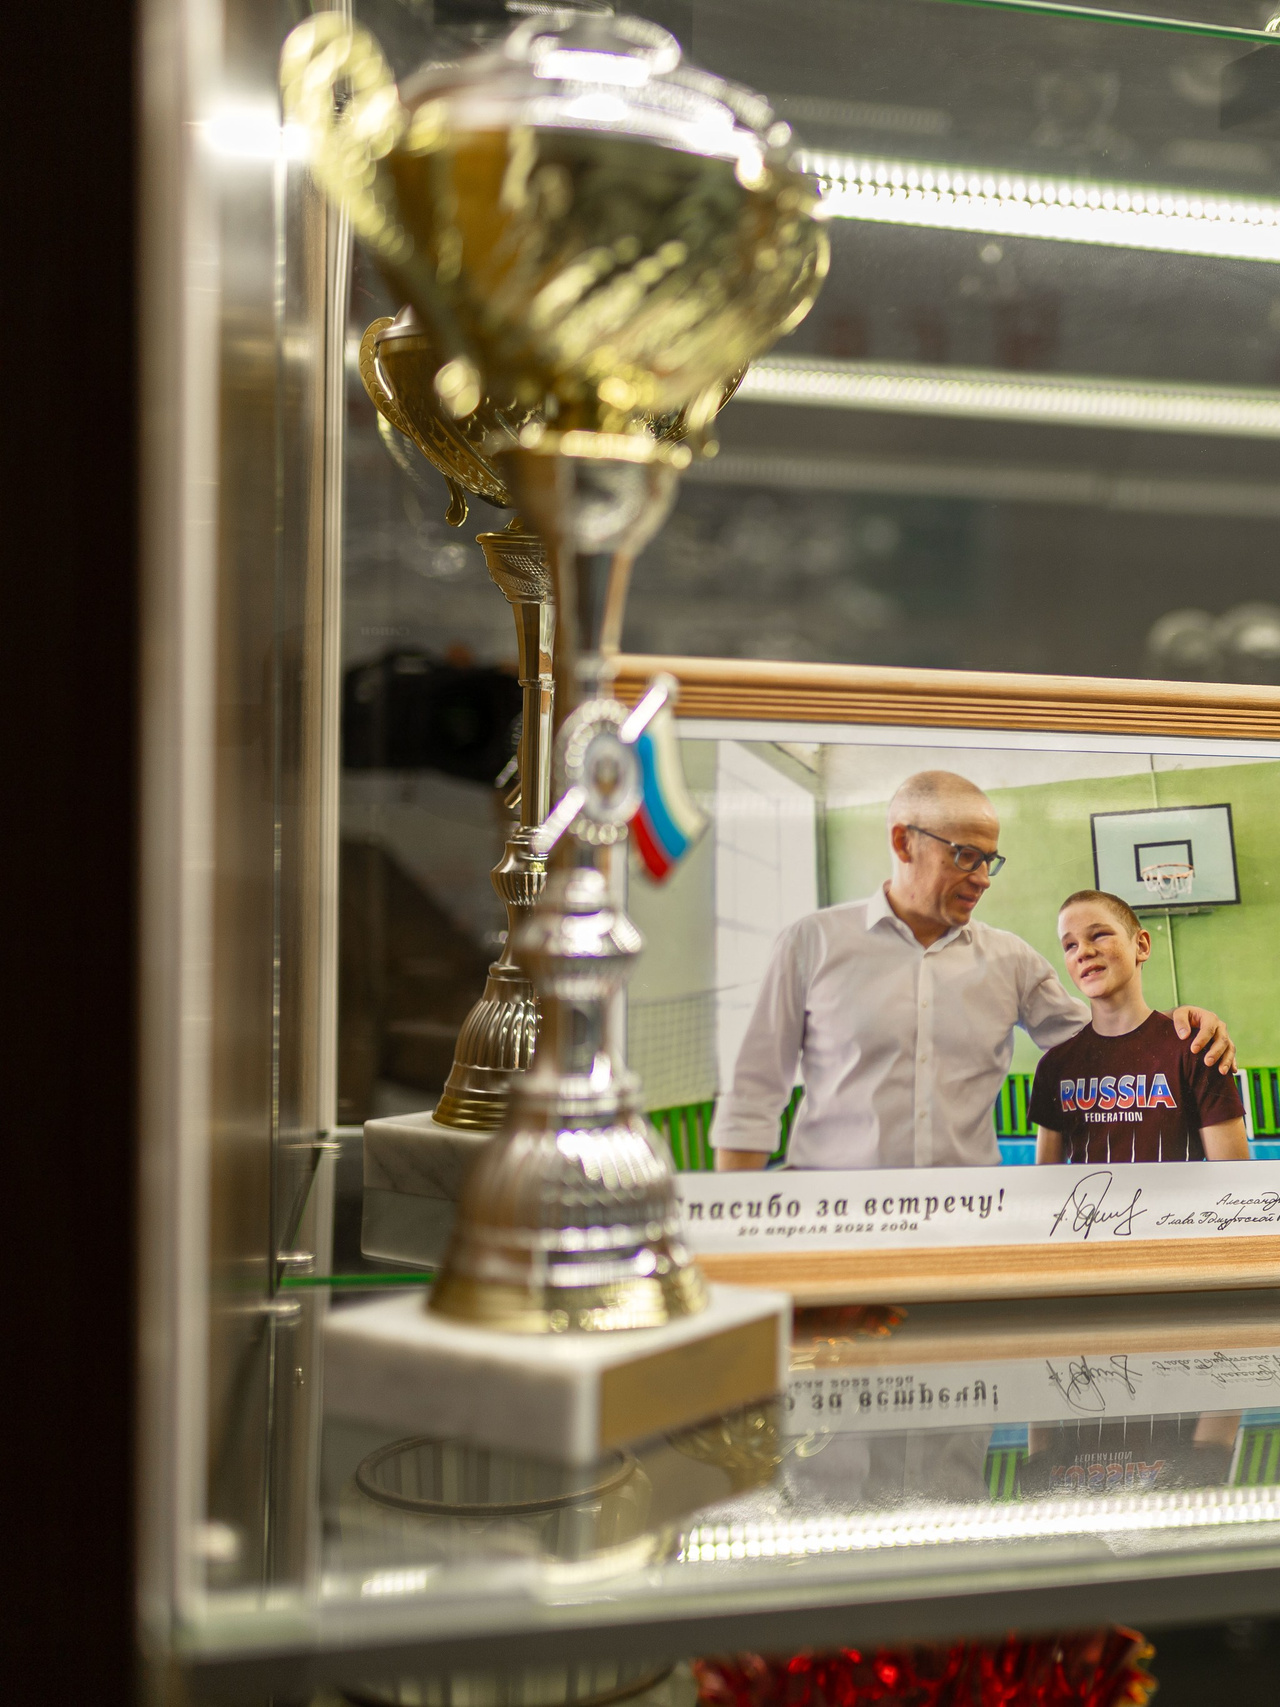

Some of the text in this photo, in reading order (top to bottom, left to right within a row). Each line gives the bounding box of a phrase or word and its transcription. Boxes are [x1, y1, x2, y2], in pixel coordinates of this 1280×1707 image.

[1060, 1073, 1178, 1112] RUSSIA
[1084, 1111, 1143, 1122] FEDERATION
[680, 1188, 1005, 1221] пасибо за встречу!
[738, 1219, 918, 1237] 20 апреля 2022 года
